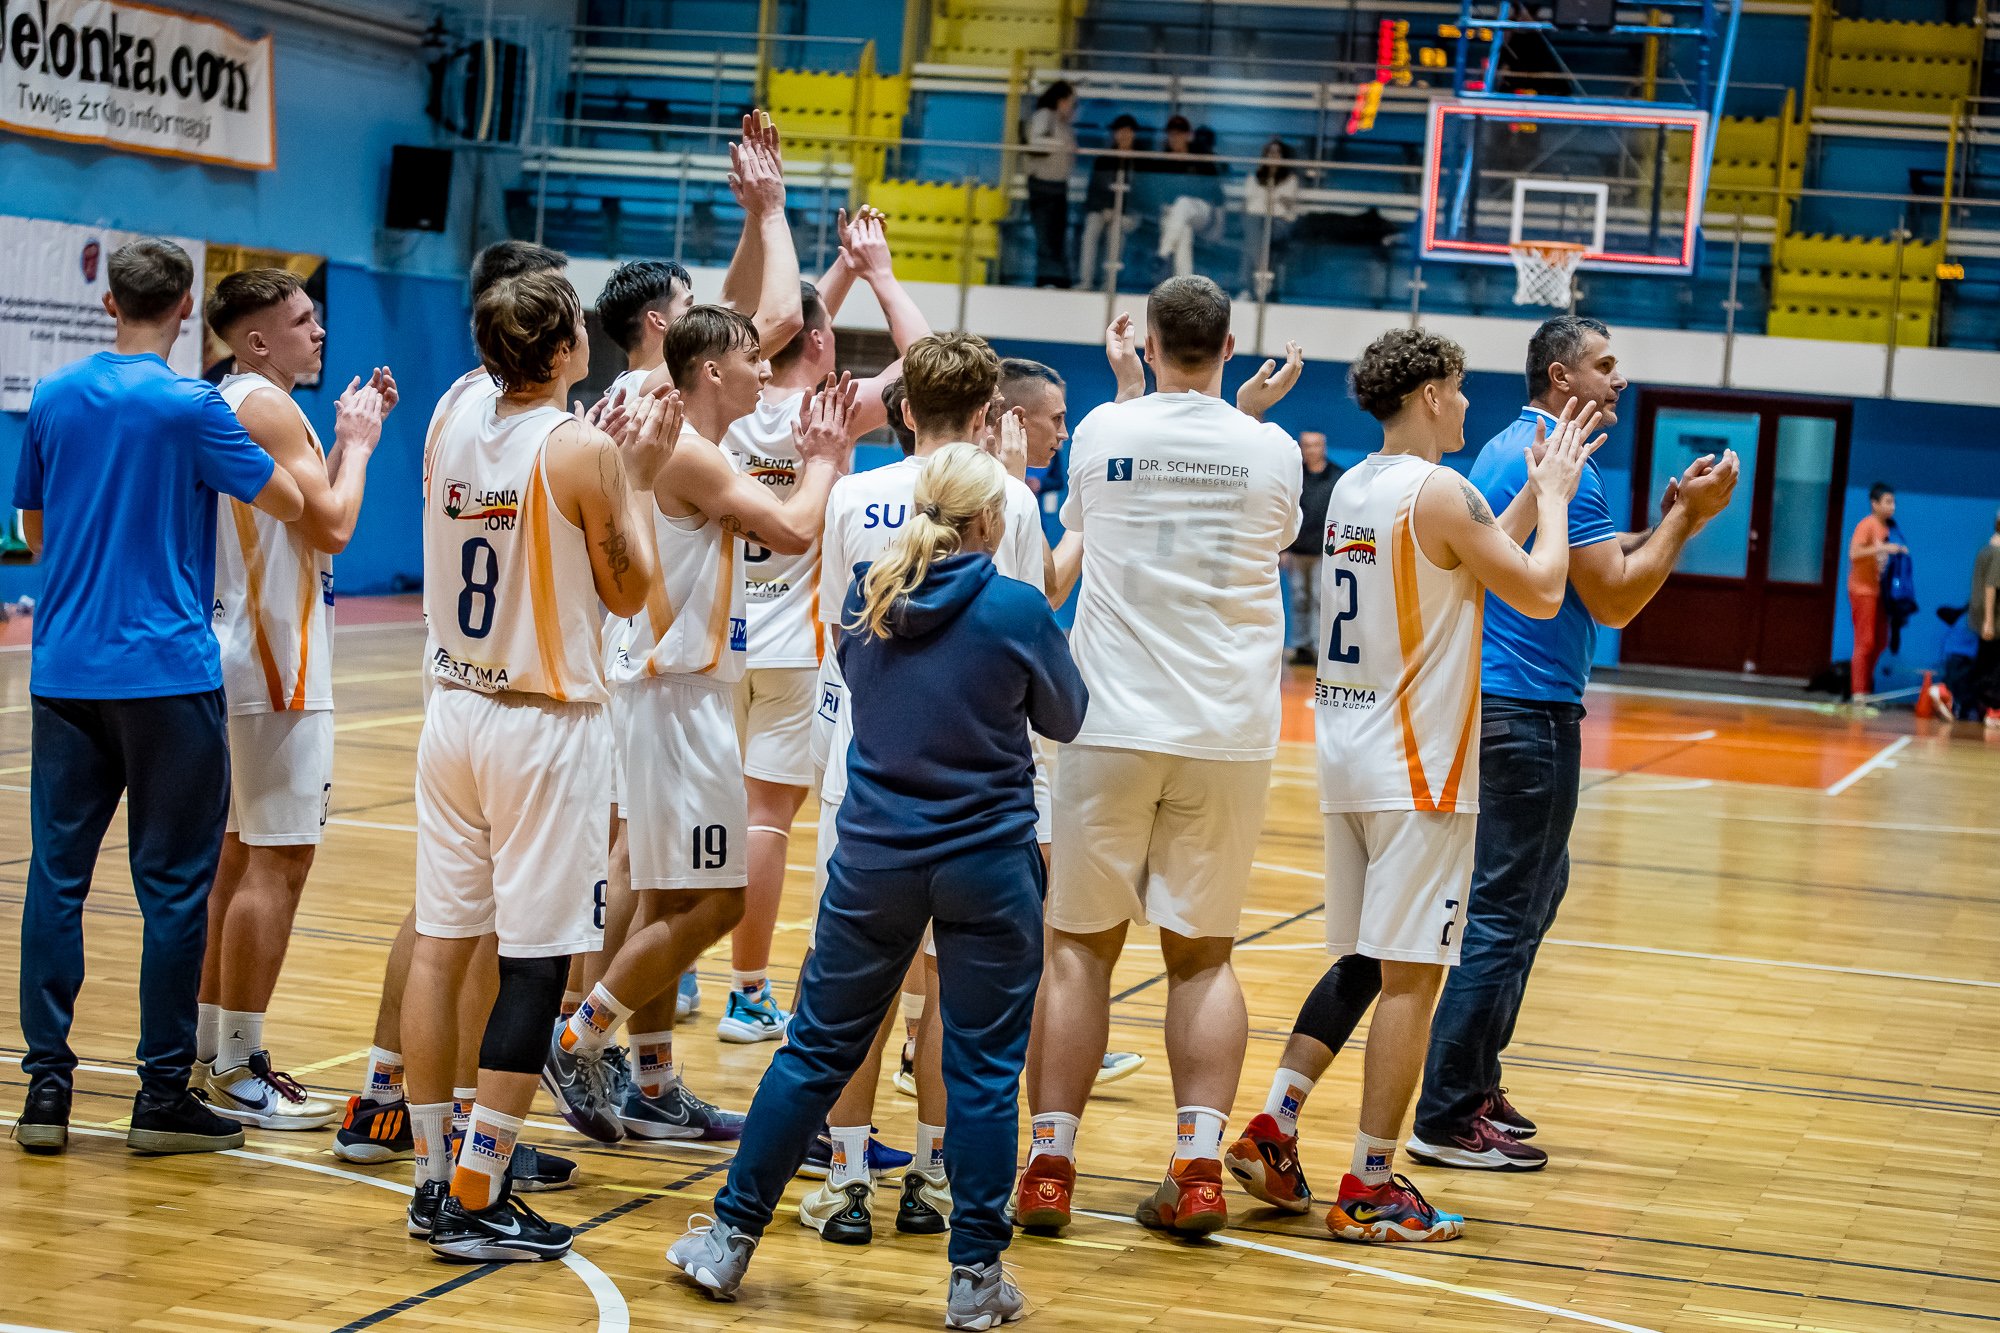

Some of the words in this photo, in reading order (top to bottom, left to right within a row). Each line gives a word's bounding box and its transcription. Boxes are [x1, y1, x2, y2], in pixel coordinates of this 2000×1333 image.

[18, 82, 72, 122] Twoje
[1138, 459, 1163, 471] DR.
[1167, 460, 1249, 478] SCHNEIDER
[1138, 474, 1248, 489] UNTERNEHMENSGRUPPE
[1341, 524, 1376, 543] JELENIA
[458, 536, 499, 640] 8
[1328, 568, 1361, 665] 2
[692, 824, 727, 869] 19
[471, 1144, 511, 1162] SUDETY
